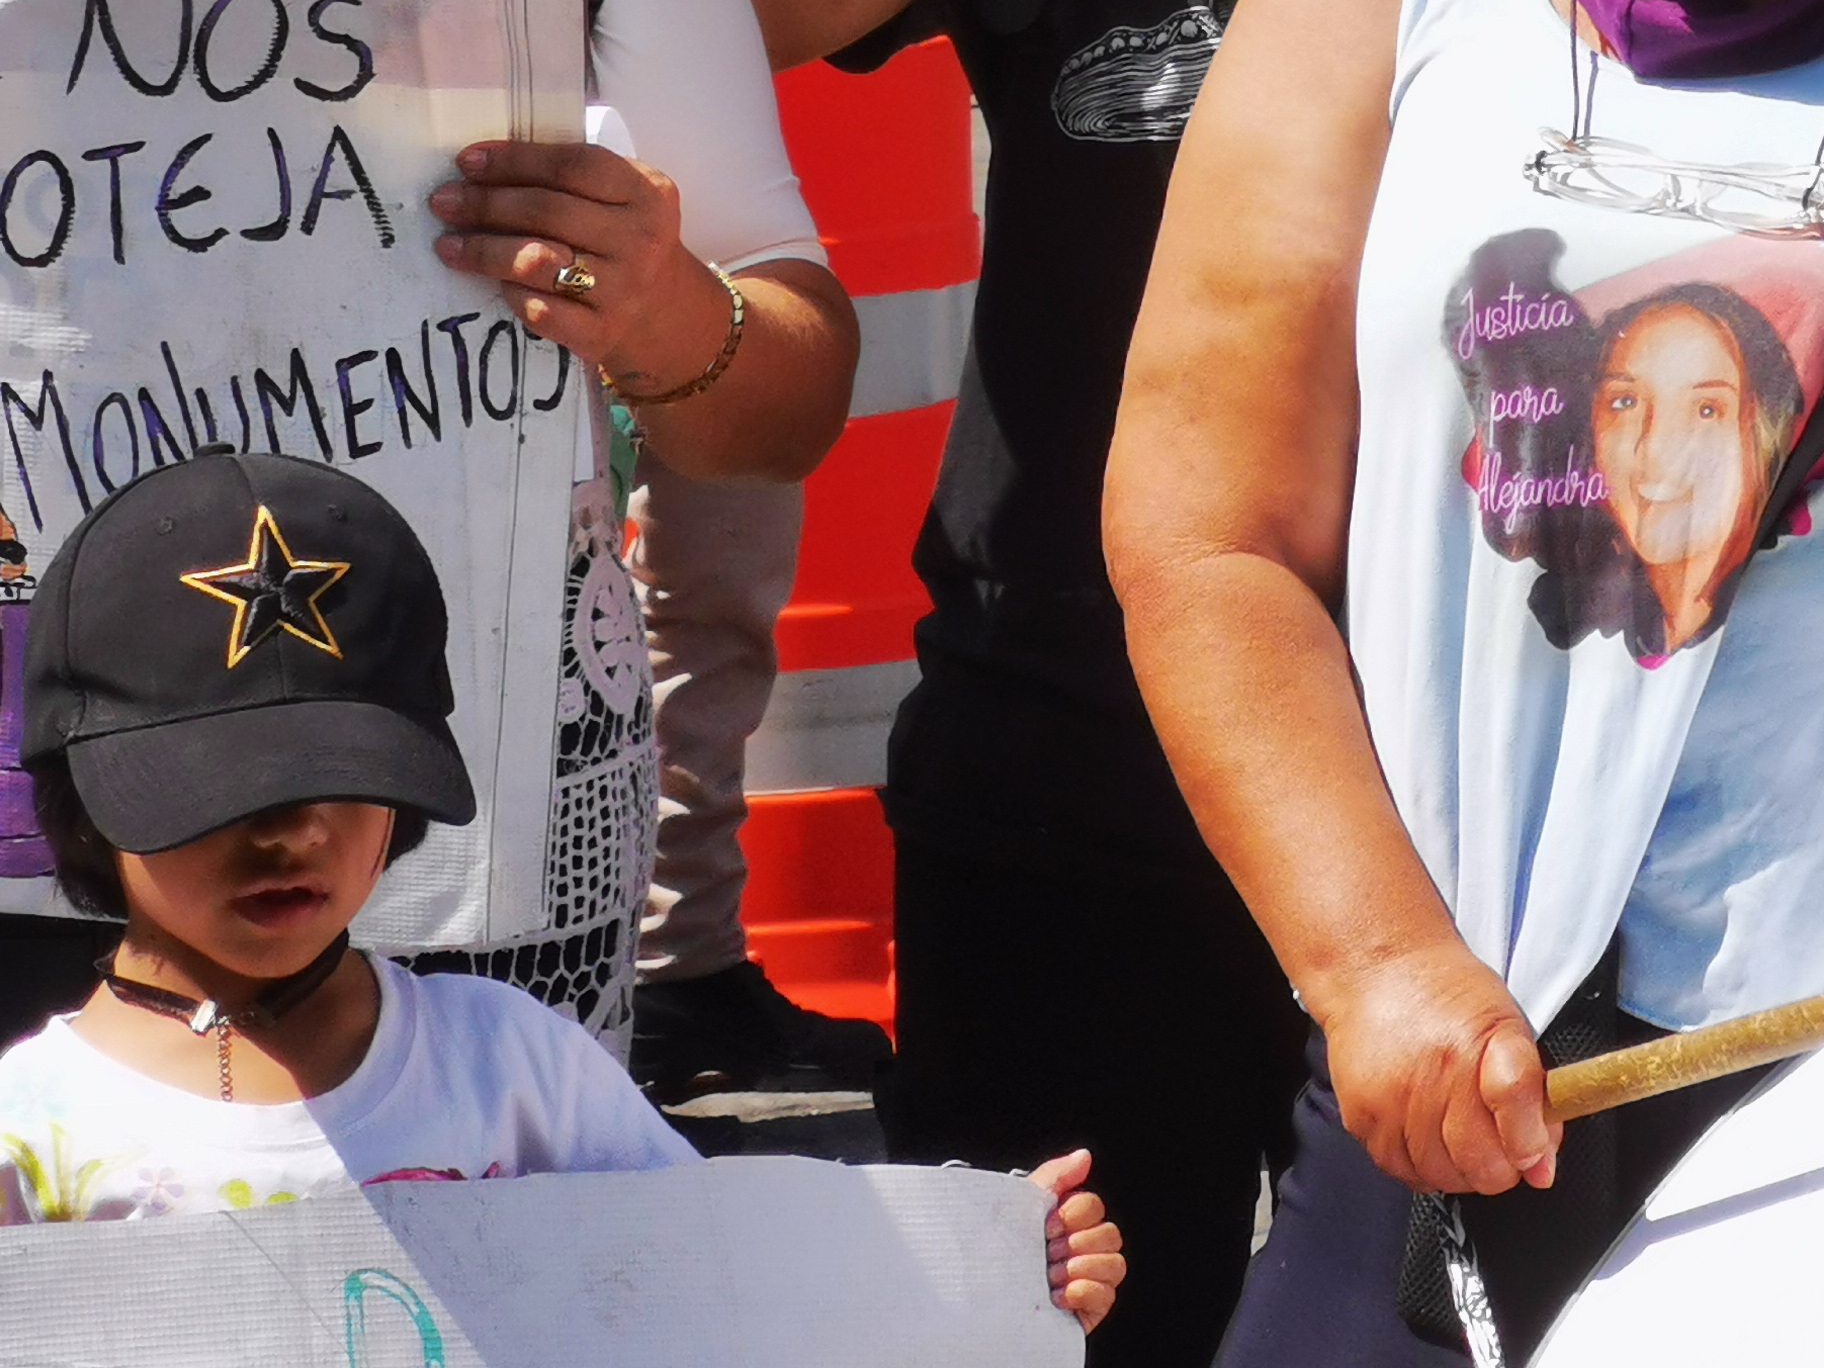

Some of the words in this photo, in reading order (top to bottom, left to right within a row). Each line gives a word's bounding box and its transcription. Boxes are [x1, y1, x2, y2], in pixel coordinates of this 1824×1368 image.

[1458, 281, 1575, 360] Justicia
[1489, 385, 1564, 448] para
[1478, 443, 1610, 535] Alejandra
